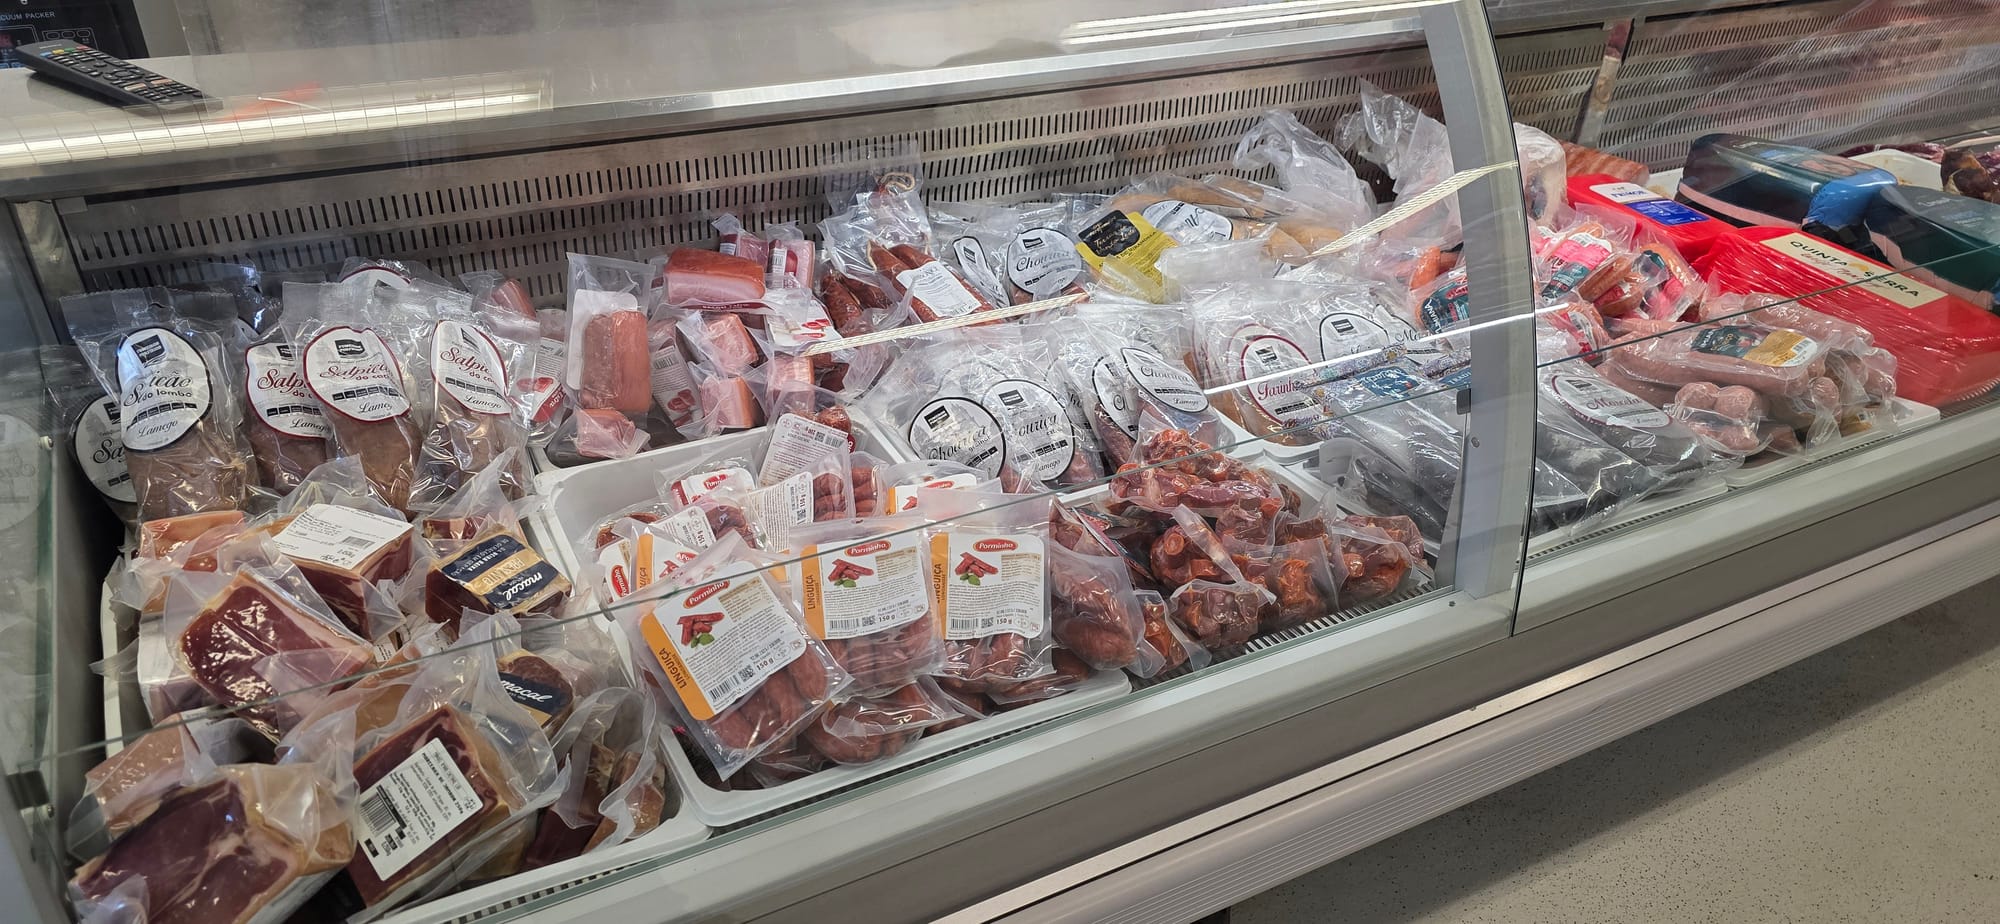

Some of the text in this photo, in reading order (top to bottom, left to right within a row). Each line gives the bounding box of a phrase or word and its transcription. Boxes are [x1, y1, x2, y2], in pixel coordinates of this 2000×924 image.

[25, 11, 55, 19] PACKER
[1789, 240, 1848, 266] QUINTA
[1864, 270, 1920, 298] SERRA
[257, 368, 307, 394] Salp
[157, 389, 193, 398] lombo
[464, 394, 503, 409] Lamego
[138, 421, 178, 438] Lamego
[850, 542, 887, 555] Porminho
[978, 541, 1014, 551] Porminho
[502, 571, 543, 601] macal
[639, 567, 648, 589] UIÇA
[688, 581, 725, 605] Porminho
[805, 574, 816, 610] LINGUIÇA
[878, 615, 890, 623] 150
[659, 647, 687, 689] LINGUIÇA
[757, 660, 770, 671] 150
[499, 679, 554, 706] macal
